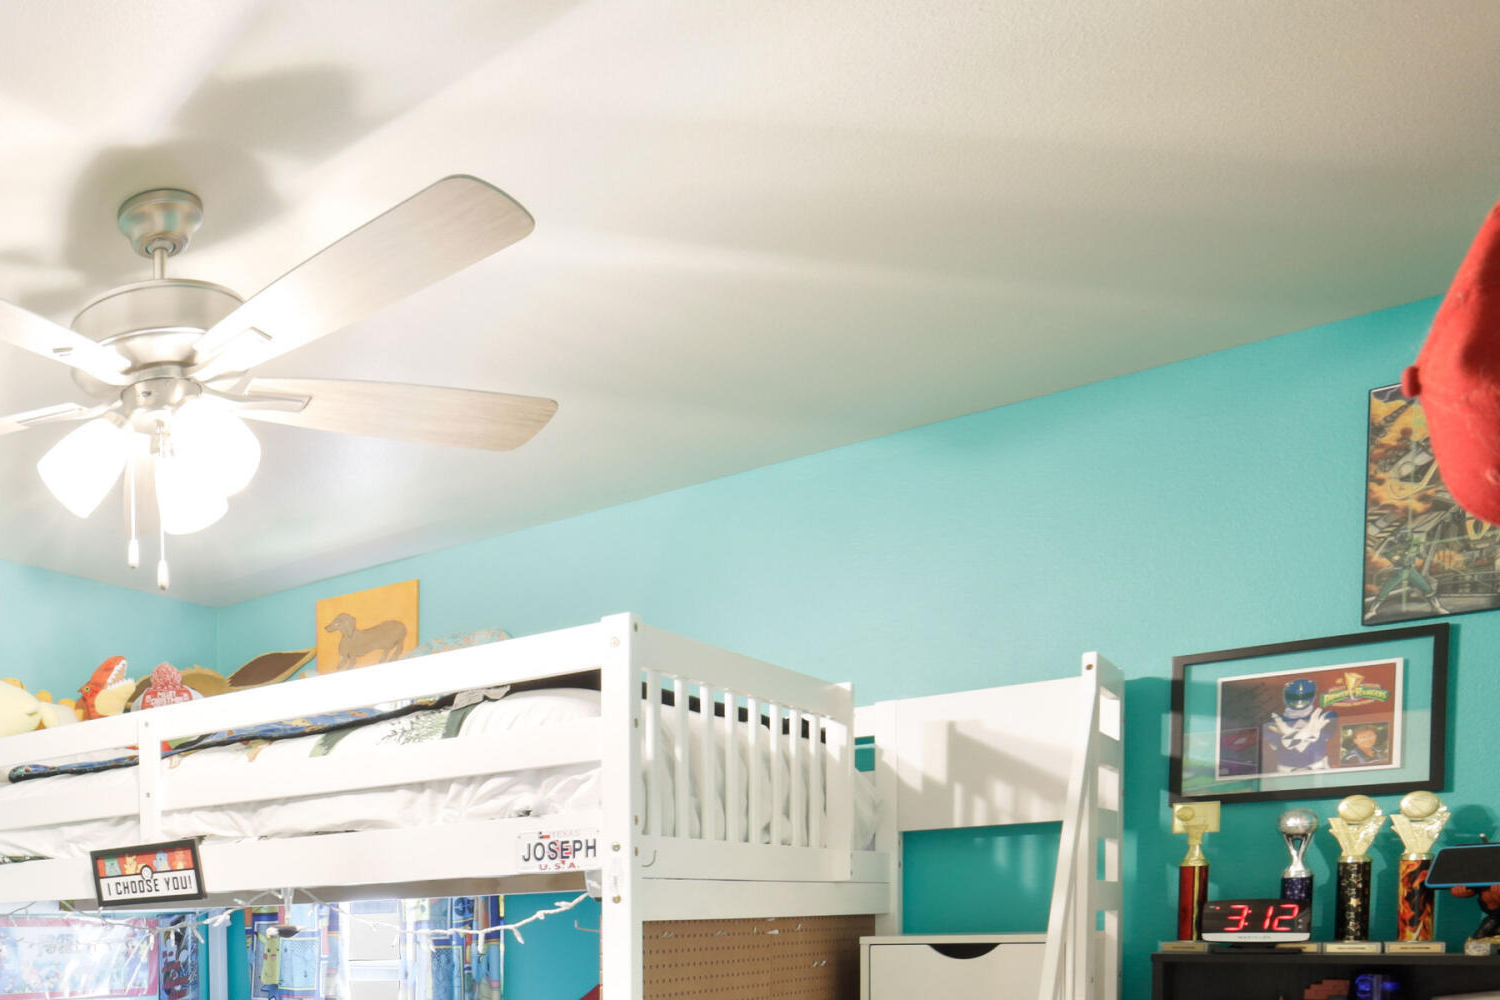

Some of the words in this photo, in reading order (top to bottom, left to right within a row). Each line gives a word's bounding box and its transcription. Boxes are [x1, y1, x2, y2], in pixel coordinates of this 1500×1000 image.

[521, 838, 597, 862] JOSEPH
[107, 882, 112, 896] I
[115, 878, 160, 895] CHOOSE
[164, 875, 193, 891] YOU!
[1223, 904, 1300, 932] 3:12
